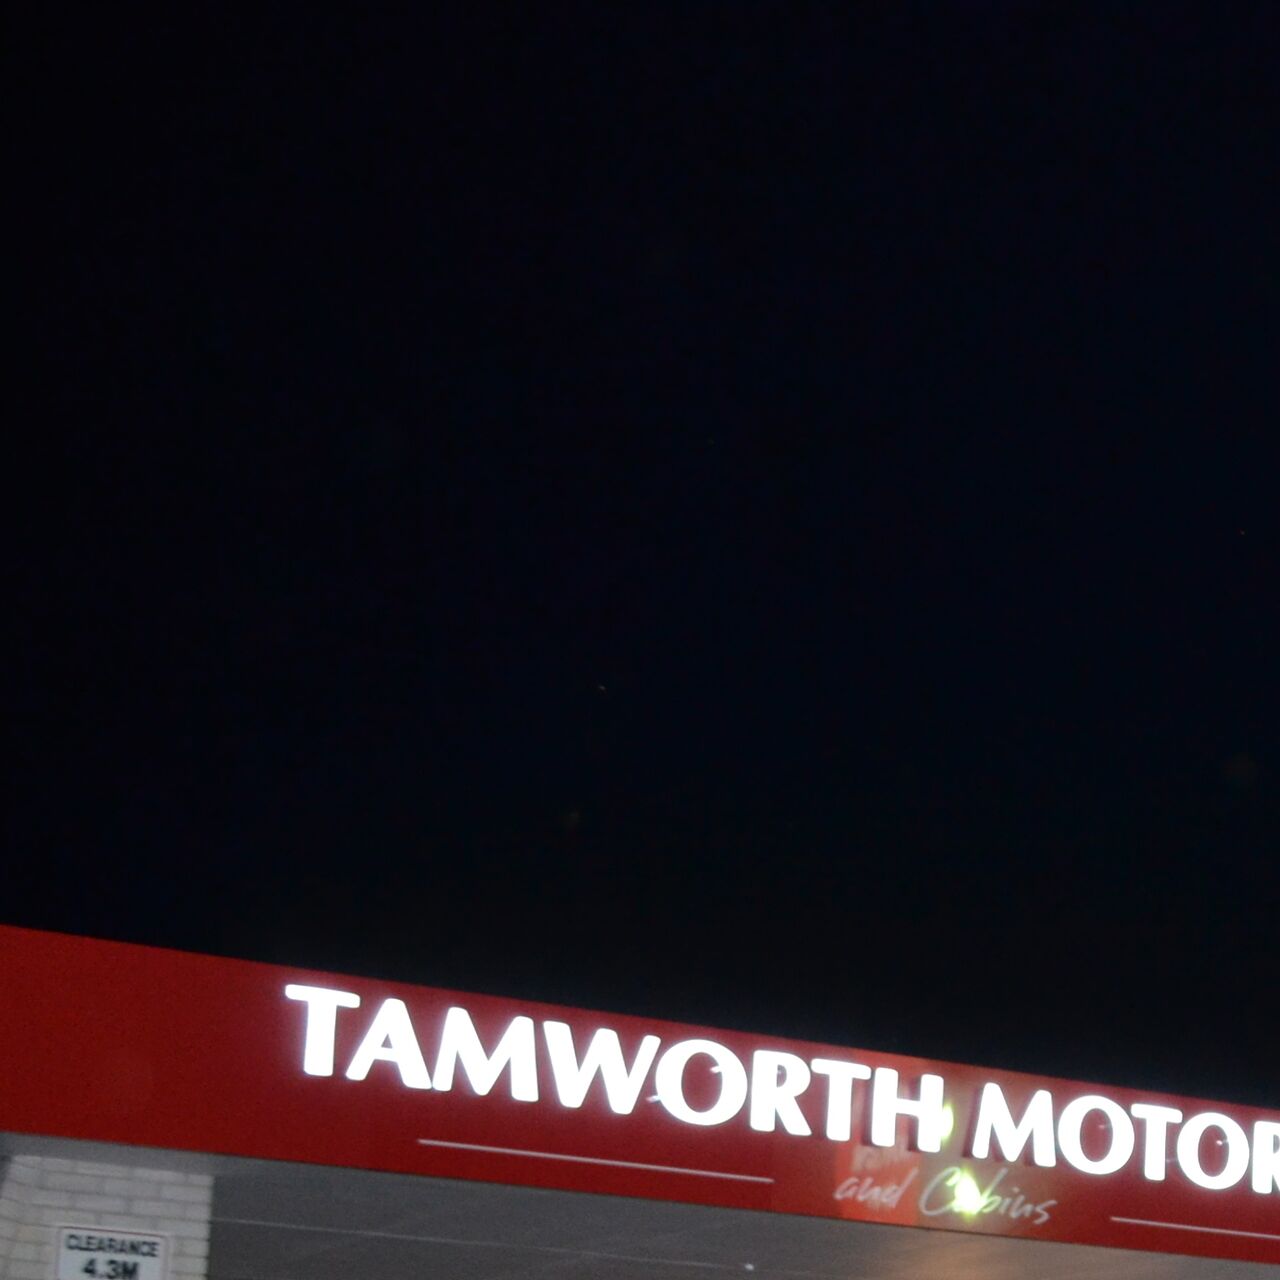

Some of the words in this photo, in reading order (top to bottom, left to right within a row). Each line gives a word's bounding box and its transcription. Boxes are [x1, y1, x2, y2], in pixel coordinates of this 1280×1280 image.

[284, 983, 946, 1153] TAMWORTH
[833, 1167, 918, 1210] and
[918, 1166, 1059, 1226] Cbins
[65, 1233, 160, 1258] CLEARANCE
